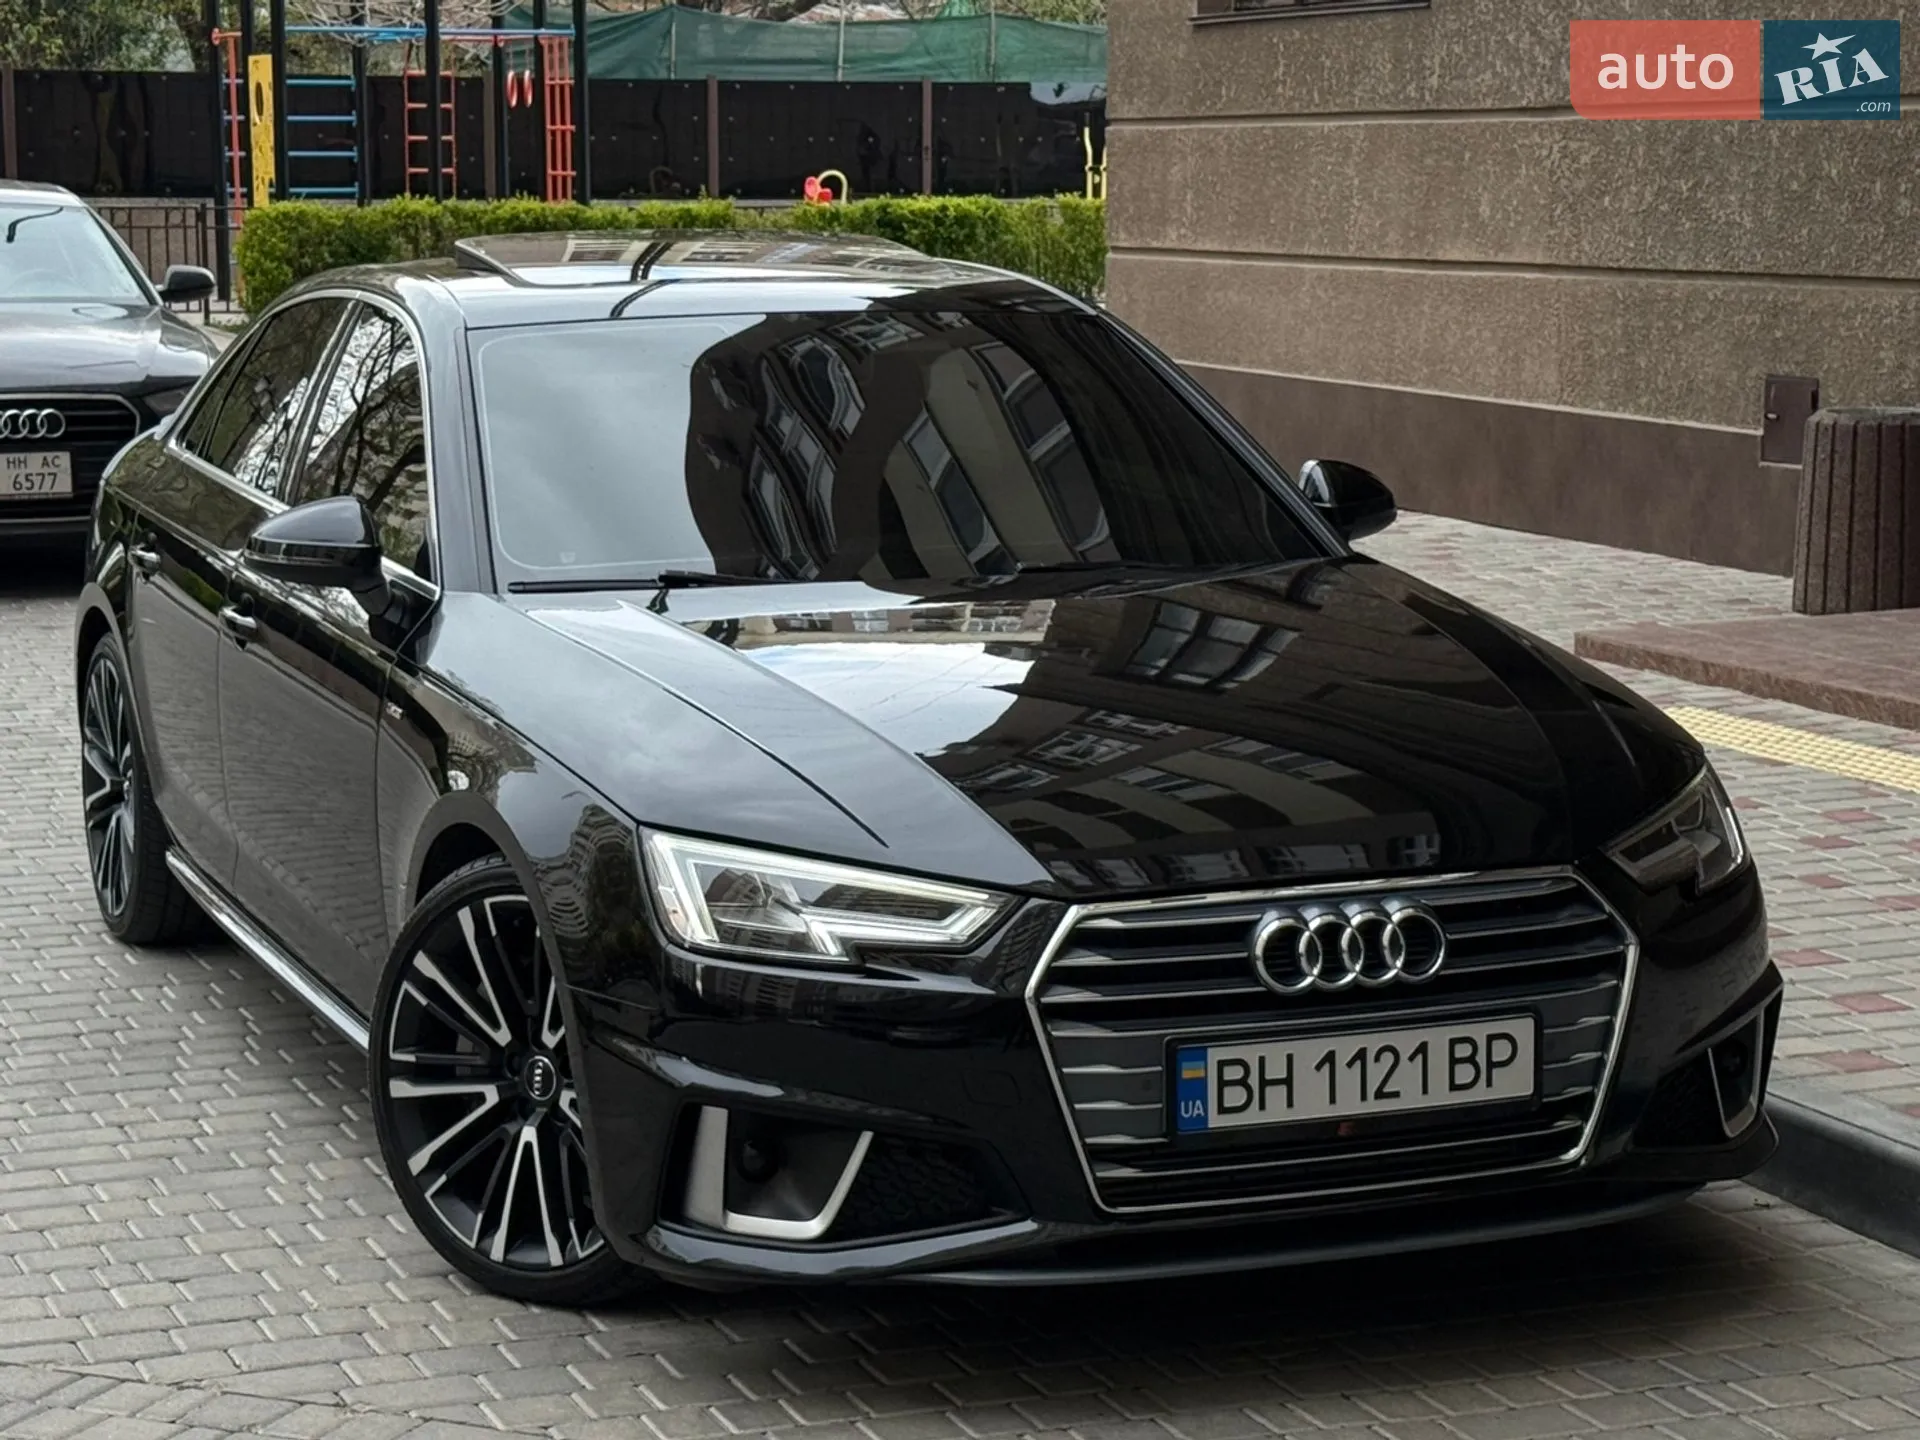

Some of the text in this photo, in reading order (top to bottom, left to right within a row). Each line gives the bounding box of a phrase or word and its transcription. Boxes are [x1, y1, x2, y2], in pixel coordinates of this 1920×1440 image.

[41, 455, 61, 469] AC
[13, 472, 58, 491] 6577
[1216, 1032, 1518, 1116] BH 1121 BP
[1180, 1100, 1206, 1119] UA
